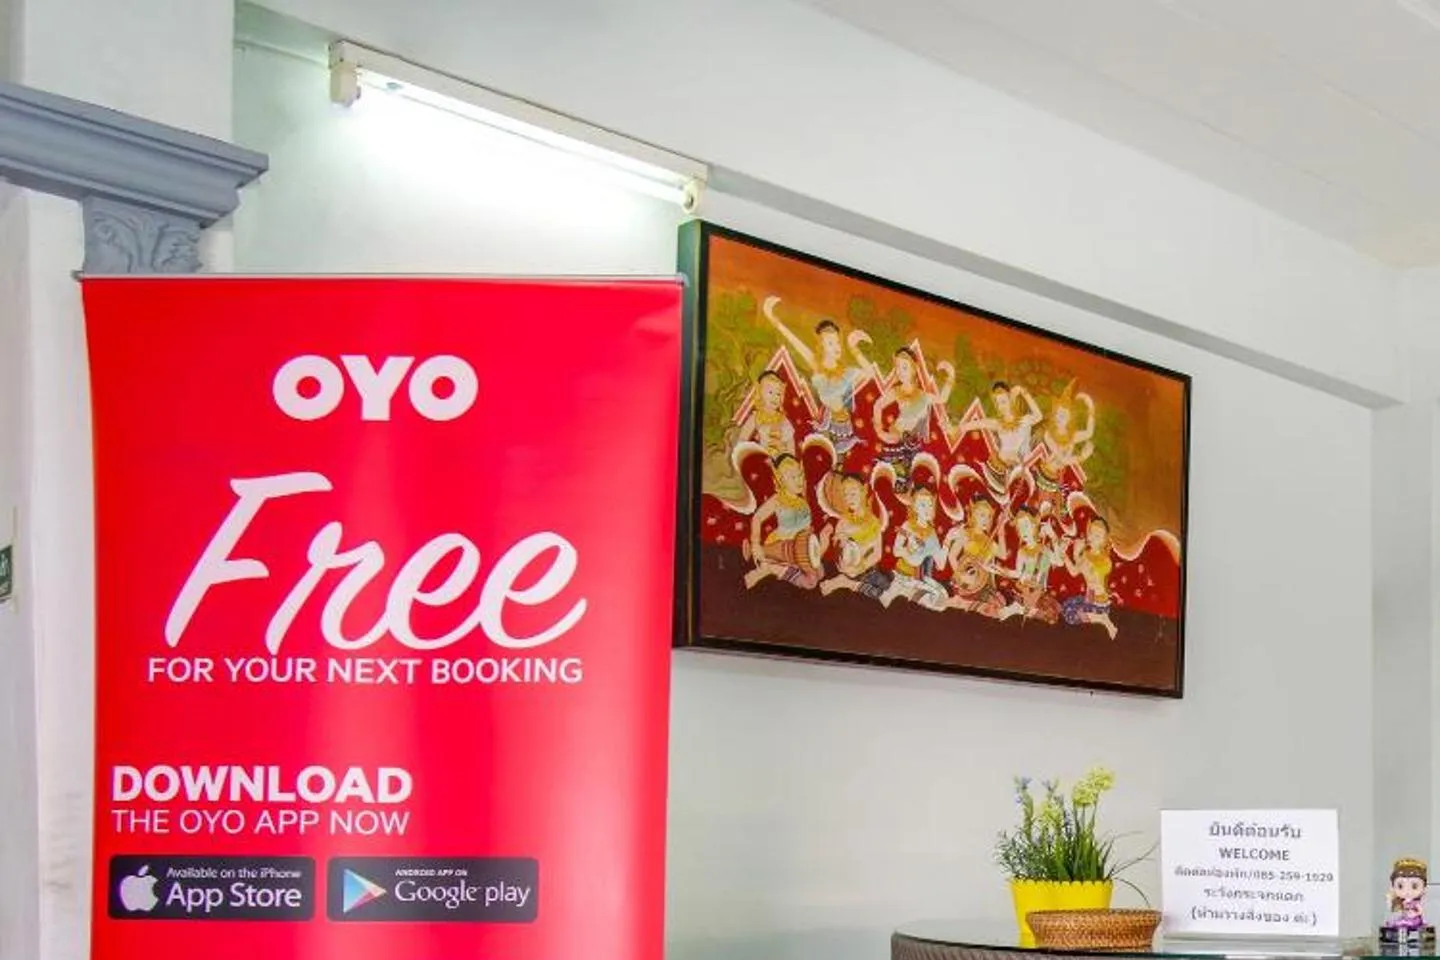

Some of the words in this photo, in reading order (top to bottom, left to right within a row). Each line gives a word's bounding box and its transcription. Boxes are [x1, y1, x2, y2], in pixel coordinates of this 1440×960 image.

[272, 354, 479, 421] OYO
[164, 471, 588, 655] Free
[148, 657, 213, 683] FOR
[224, 658, 316, 683] YOUR
[327, 658, 422, 684] NEXT
[431, 657, 585, 686] BOOKING
[113, 765, 413, 803] DOWNLOAD
[112, 810, 169, 834] THE
[179, 810, 245, 834] OYO
[255, 810, 320, 834] APP
[329, 810, 409, 835] NOW
[1218, 847, 1290, 861] WELCOME
[167, 867, 218, 879] Available
[220, 869, 236, 879] on
[238, 867, 258, 879] the
[260, 867, 302, 879] iPhone
[166, 882, 224, 913] App
[229, 882, 302, 908] Store
[395, 880, 478, 909] Google
[485, 882, 532, 908] play
